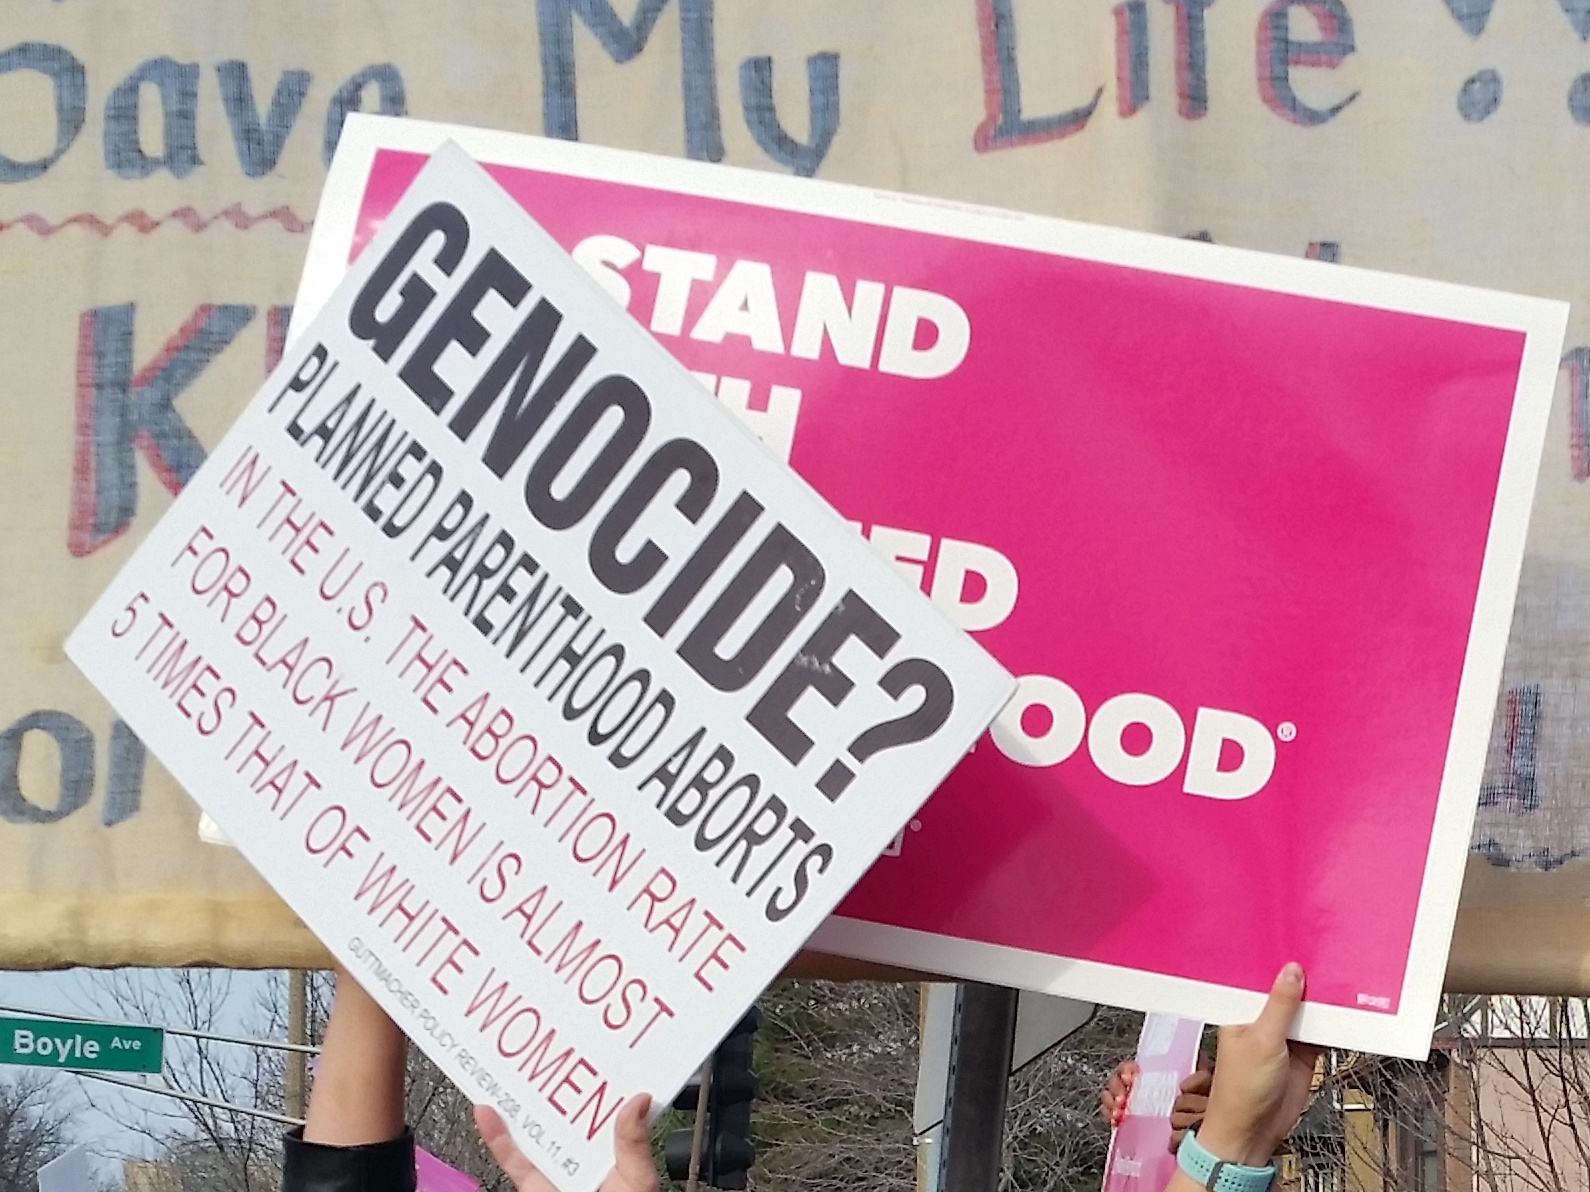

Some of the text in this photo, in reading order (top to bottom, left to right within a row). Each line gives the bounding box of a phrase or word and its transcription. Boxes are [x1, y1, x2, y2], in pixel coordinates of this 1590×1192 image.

[218, 445, 747, 993] IN THE U.S. THE ABORTION RATE
[267, 341, 835, 923] PLANNED PARENTHOOD ABORTS
[347, 200, 956, 804] GENOCIDE?
[14, 1029, 142, 1062] Boyle Ave
[111, 591, 150, 638] 5
[135, 611, 237, 736] TIMES
[224, 709, 322, 821] THAT
[305, 804, 371, 869] OF
[353, 851, 480, 996] WHITE
[464, 966, 625, 1141] WOMEN
[171, 525, 252, 623] FOR
[235, 594, 359, 732] BLACK
[340, 700, 487, 867] WOMEN
[466, 839, 523, 903] IS
[501, 884, 676, 1049] ALMOST
[414, 1007, 463, 1052] POLICY
